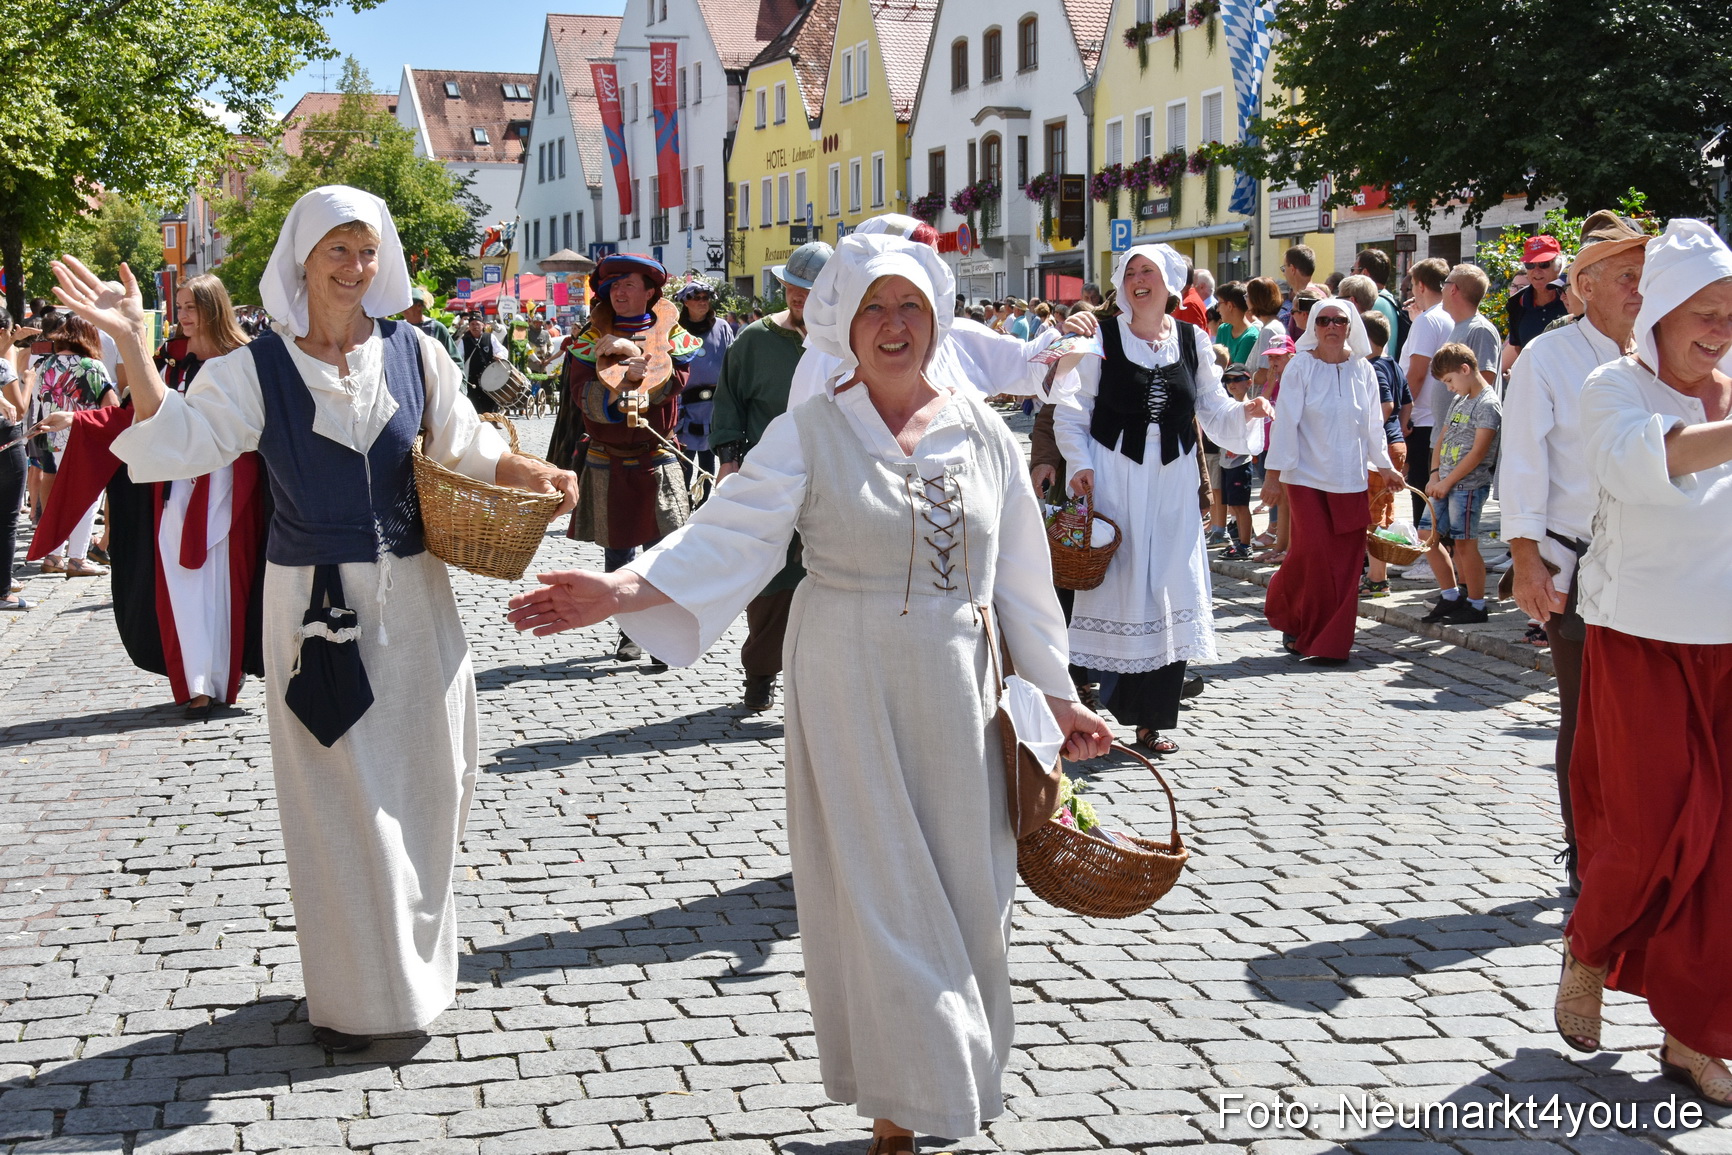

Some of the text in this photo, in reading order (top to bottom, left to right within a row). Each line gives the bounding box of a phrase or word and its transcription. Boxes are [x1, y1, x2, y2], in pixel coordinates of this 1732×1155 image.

[652, 47, 667, 87] K&L
[767, 145, 815, 169] HOTEL Lehmeier
[1156, 202, 1169, 213] MEHR
[1115, 223, 1127, 248] P
